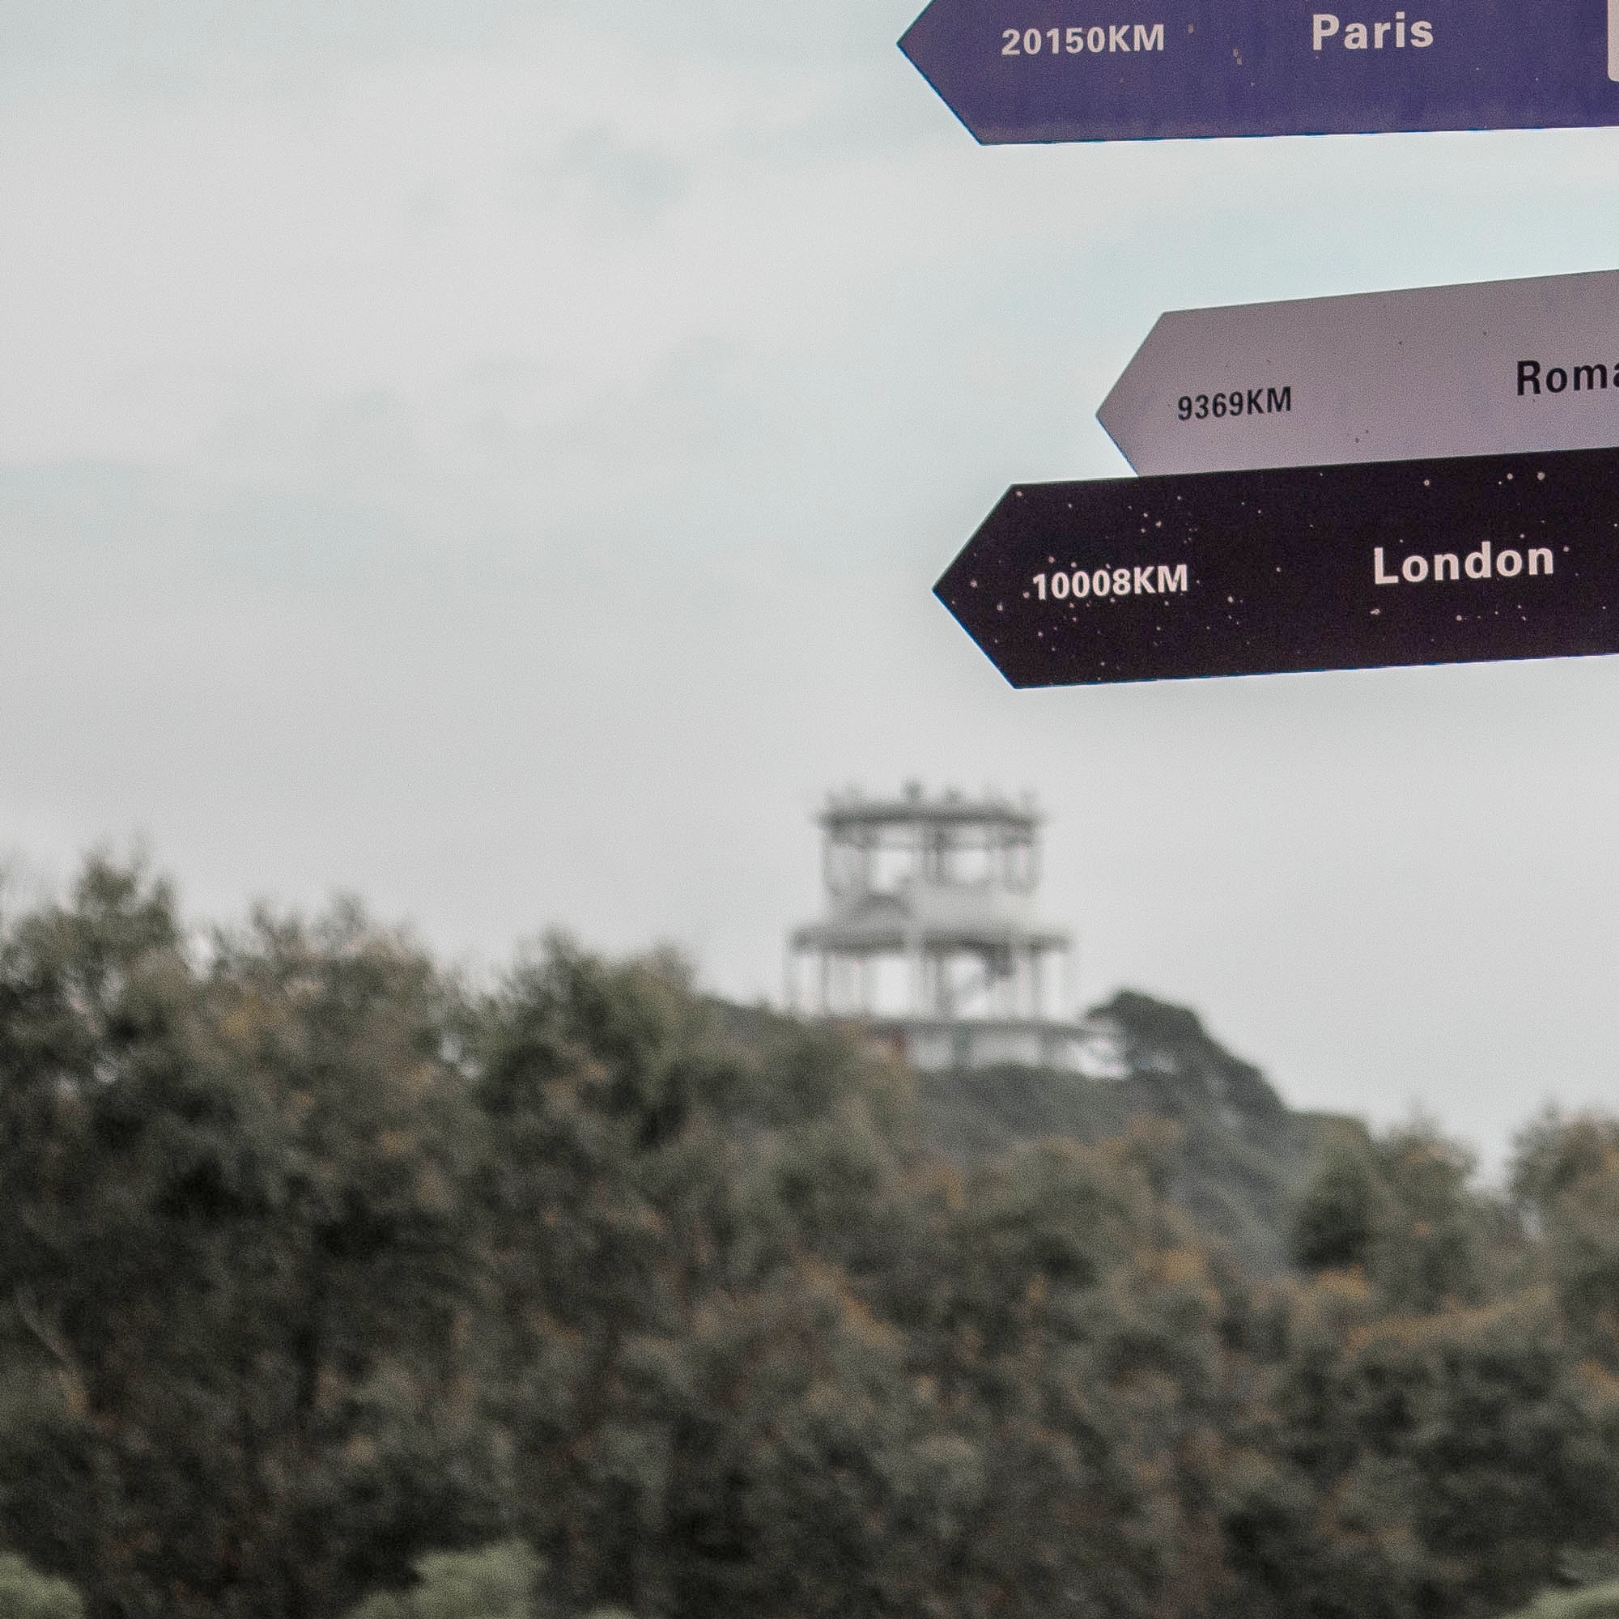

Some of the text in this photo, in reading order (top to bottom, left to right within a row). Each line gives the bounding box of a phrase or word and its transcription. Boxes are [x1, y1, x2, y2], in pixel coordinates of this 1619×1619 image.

[1002, 22, 1166, 57] 20150KM
[1311, 11, 1434, 52] Paris
[1176, 385, 1293, 422] 9369KM
[1030, 564, 1189, 601] 10008KM
[1373, 541, 1555, 587] London
